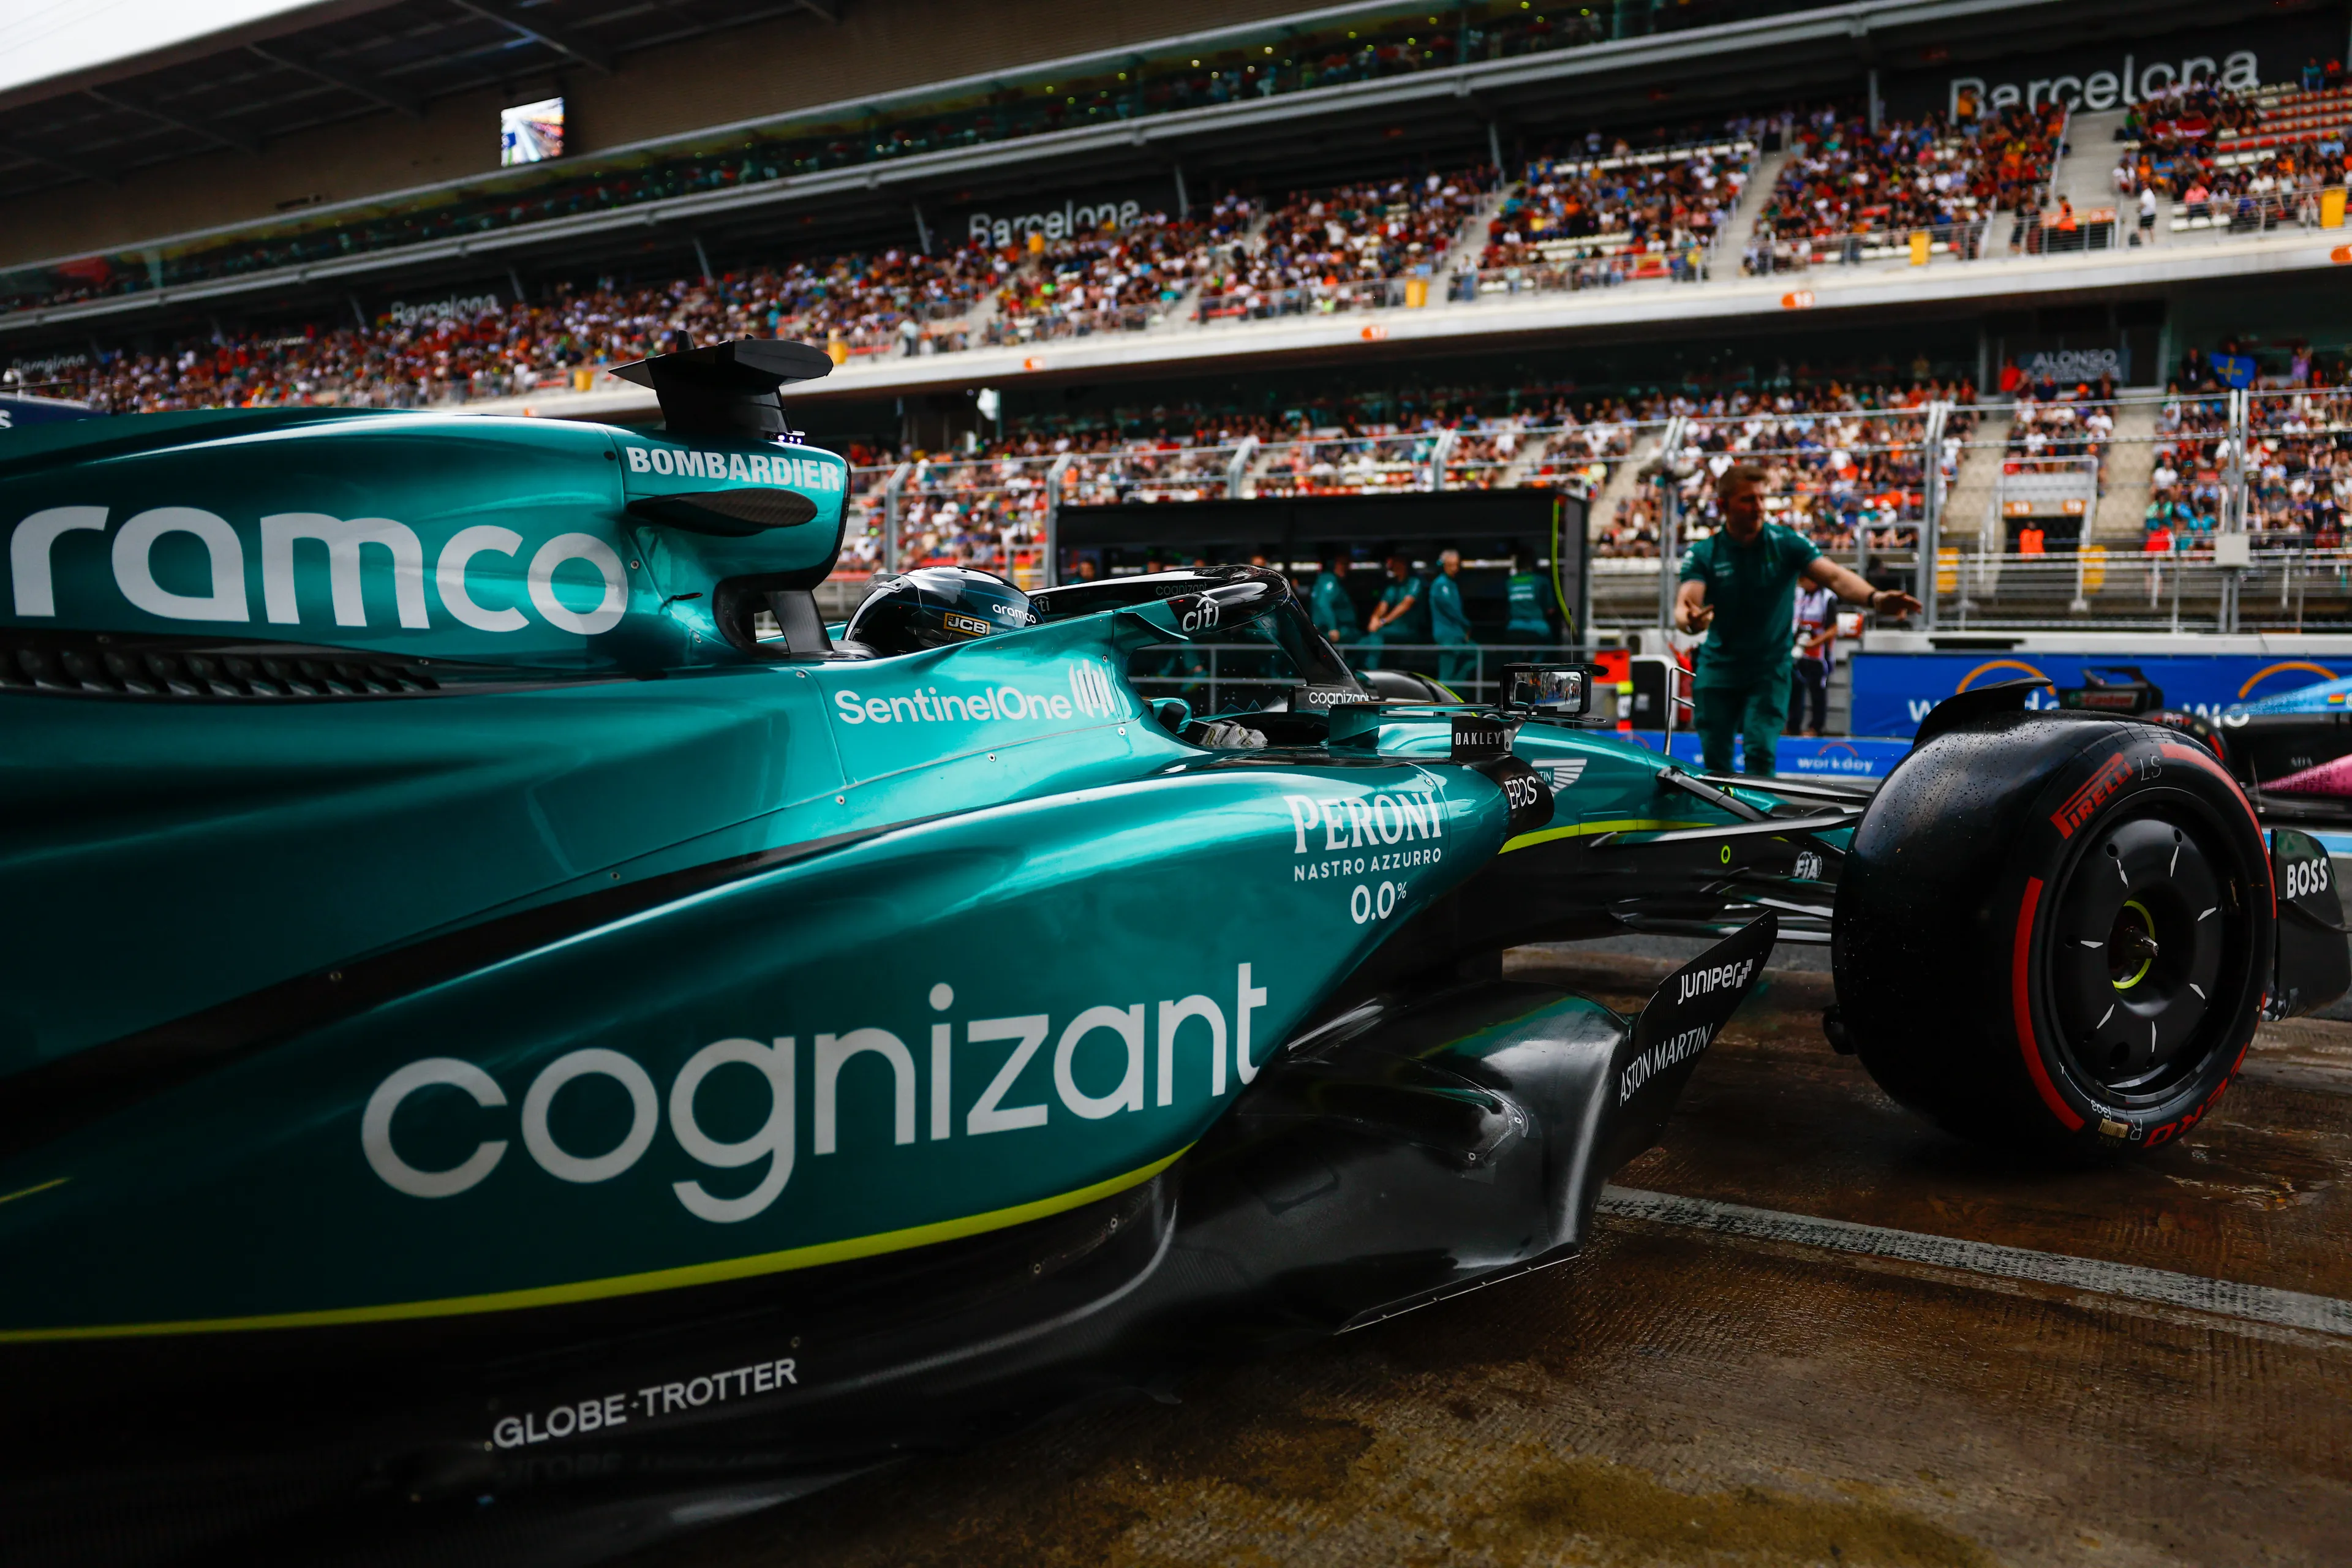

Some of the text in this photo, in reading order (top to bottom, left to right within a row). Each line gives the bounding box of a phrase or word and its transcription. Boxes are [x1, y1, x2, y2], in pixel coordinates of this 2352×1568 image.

[1949, 50, 2260, 126] Barcelona
[625, 446, 841, 491] BOMBARDIER
[10, 505, 628, 635] ramco
[948, 616, 986, 635] JCB
[992, 603, 1036, 624] aramco
[1182, 595, 1219, 633] citi
[834, 686, 1072, 724] SentinelOne
[1309, 690, 1370, 709] cognizant
[1455, 732, 1501, 745] OAKLEY
[1798, 753, 1873, 774] workday
[1504, 775, 1537, 810] EPOS
[2050, 753, 2133, 839] PIRELLI
[1283, 791, 1442, 854] PERONI
[1294, 848, 1441, 882] NASTRO AZZURRO
[2287, 857, 2328, 899] BOSS
[1351, 880, 1407, 924] 0.0%
[1620, 1023, 1713, 1106] ASTON MARTIN
[361, 962, 1268, 1223] cognizant
